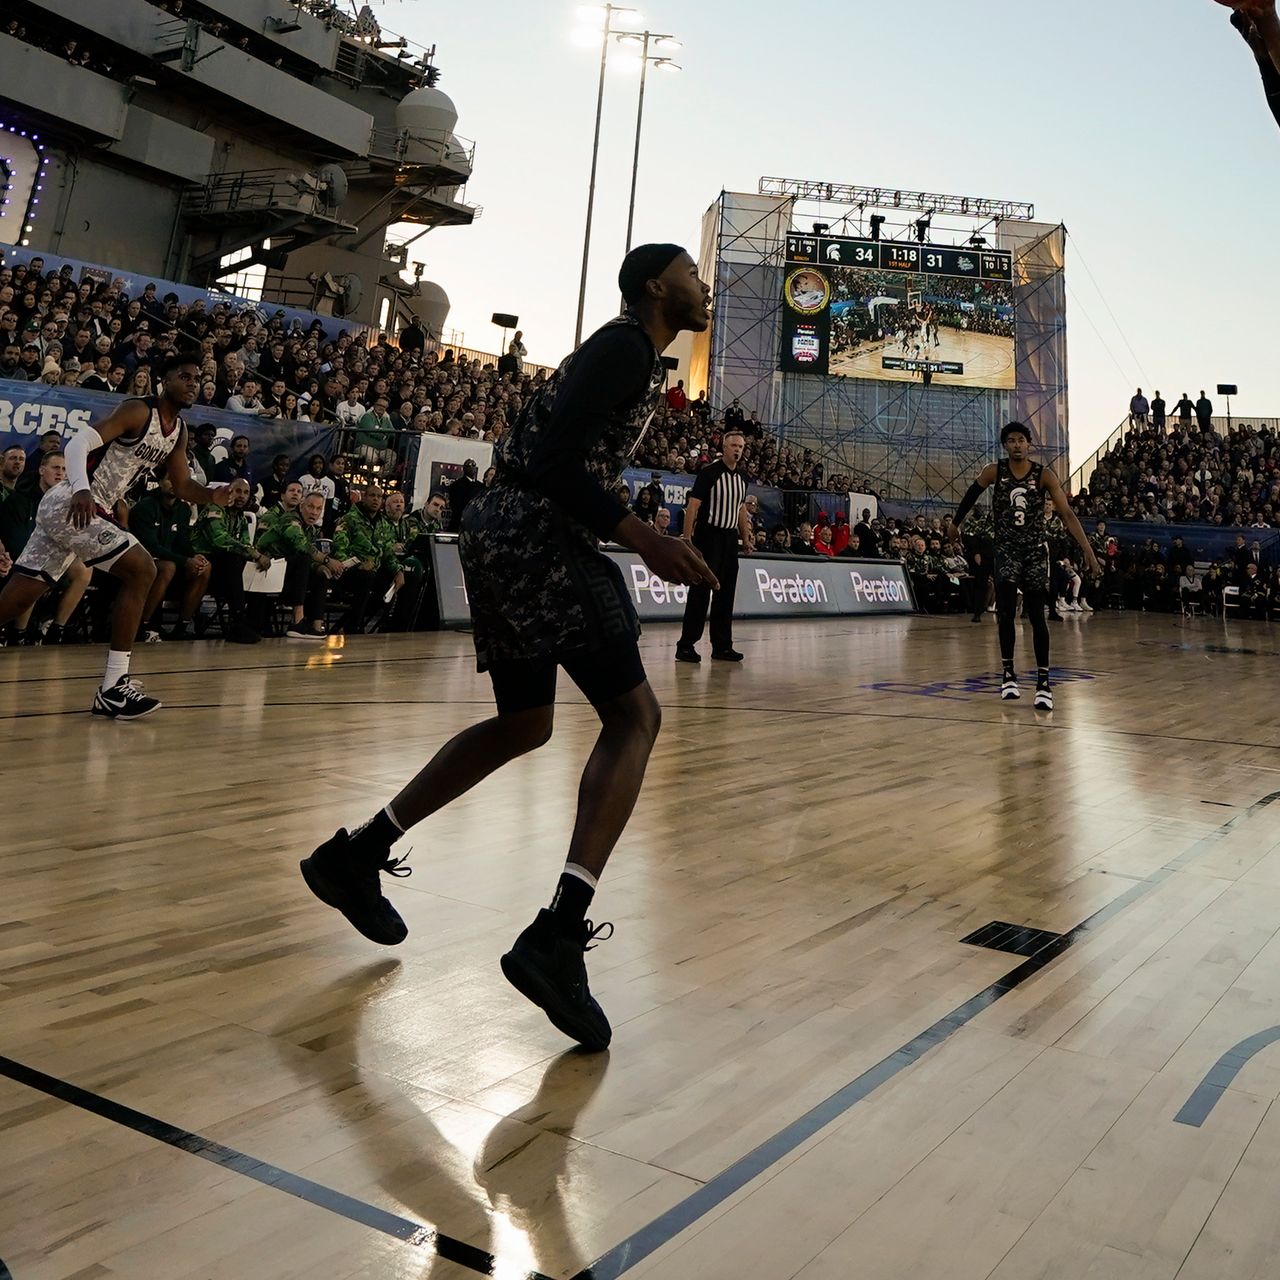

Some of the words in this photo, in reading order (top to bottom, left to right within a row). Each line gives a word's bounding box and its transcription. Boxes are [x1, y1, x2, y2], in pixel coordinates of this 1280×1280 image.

[790, 244, 795, 252] 4
[806, 245, 812, 254] 9
[855, 248, 874, 262] 34
[891, 248, 917, 261] 1:18
[927, 254, 943, 268] 31
[985, 261, 995, 270] 10
[1002, 263, 1008, 271] 3
[1014, 510, 1025, 526] 3
[631, 564, 687, 605] Pera
[755, 568, 829, 604] Peraton
[850, 571, 909, 602] Peraton
